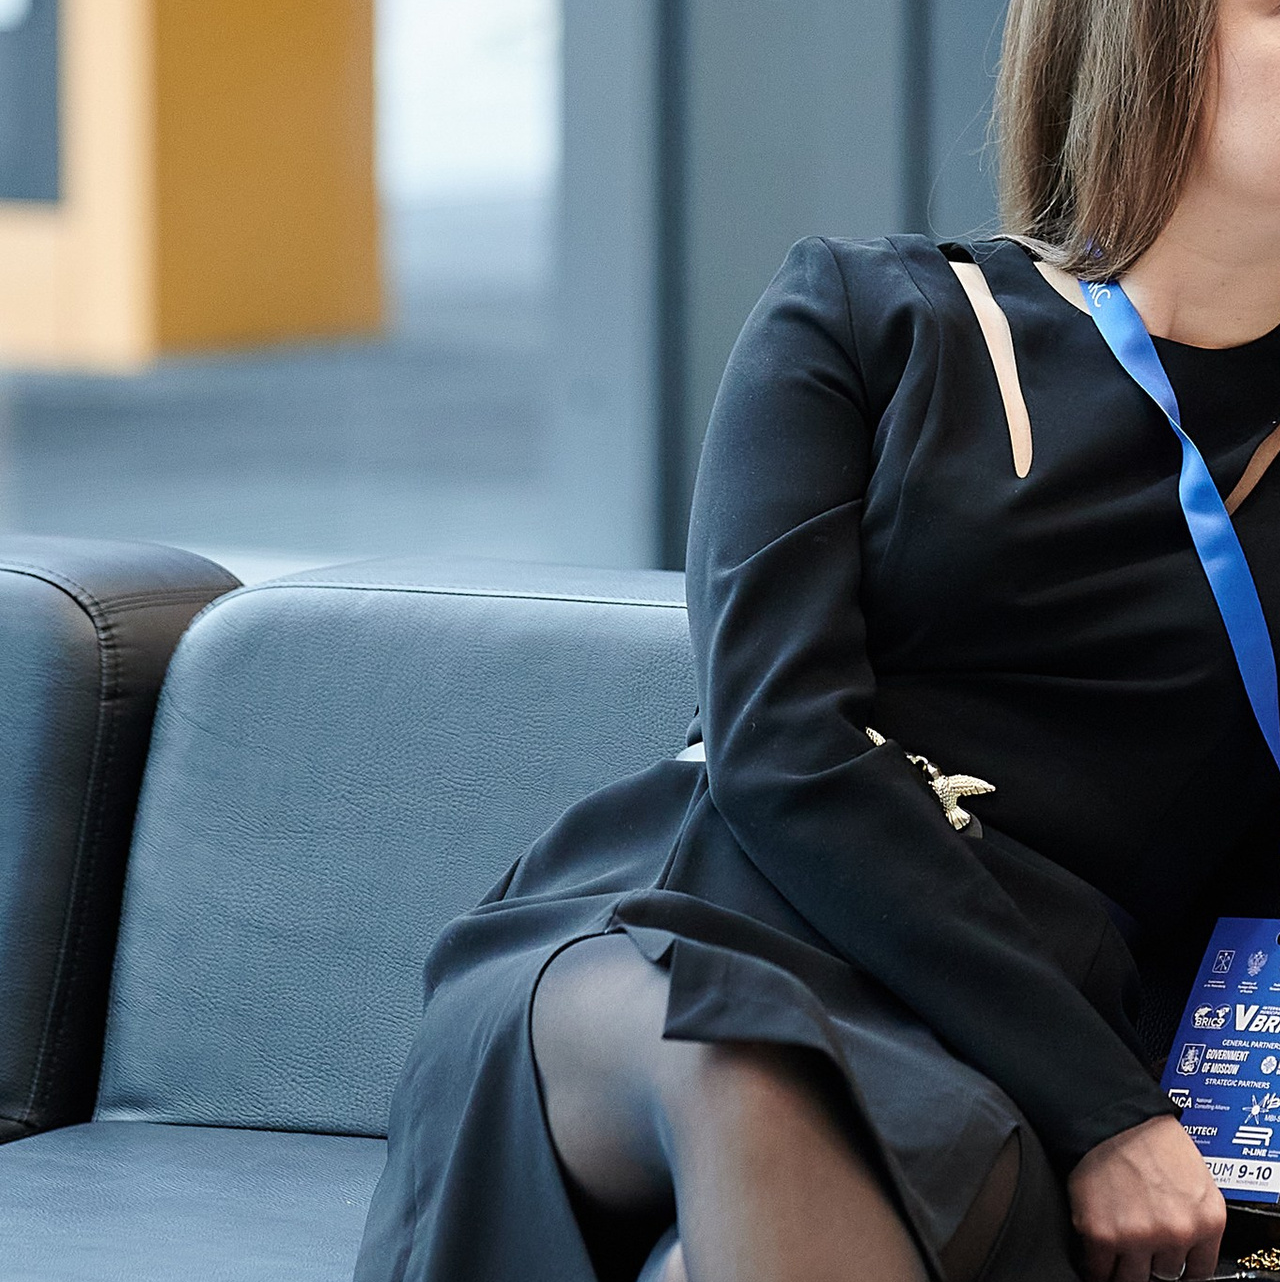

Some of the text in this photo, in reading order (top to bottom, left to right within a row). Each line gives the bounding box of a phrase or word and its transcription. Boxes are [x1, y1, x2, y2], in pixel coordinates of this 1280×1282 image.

[1222, 1039, 1250, 1048] GENERAL
[1205, 1049, 1250, 1062] GOVERNMENT
[1201, 1062, 1240, 1075] OF MOSCOW
[1205, 1078, 1271, 1089] STRATEGIC PARTNERS
[1183, 1125, 1218, 1136] OLYTECH
[1242, 1147, 1268, 1157] R-LINE
[1238, 1164, 1272, 1180] 9-10
